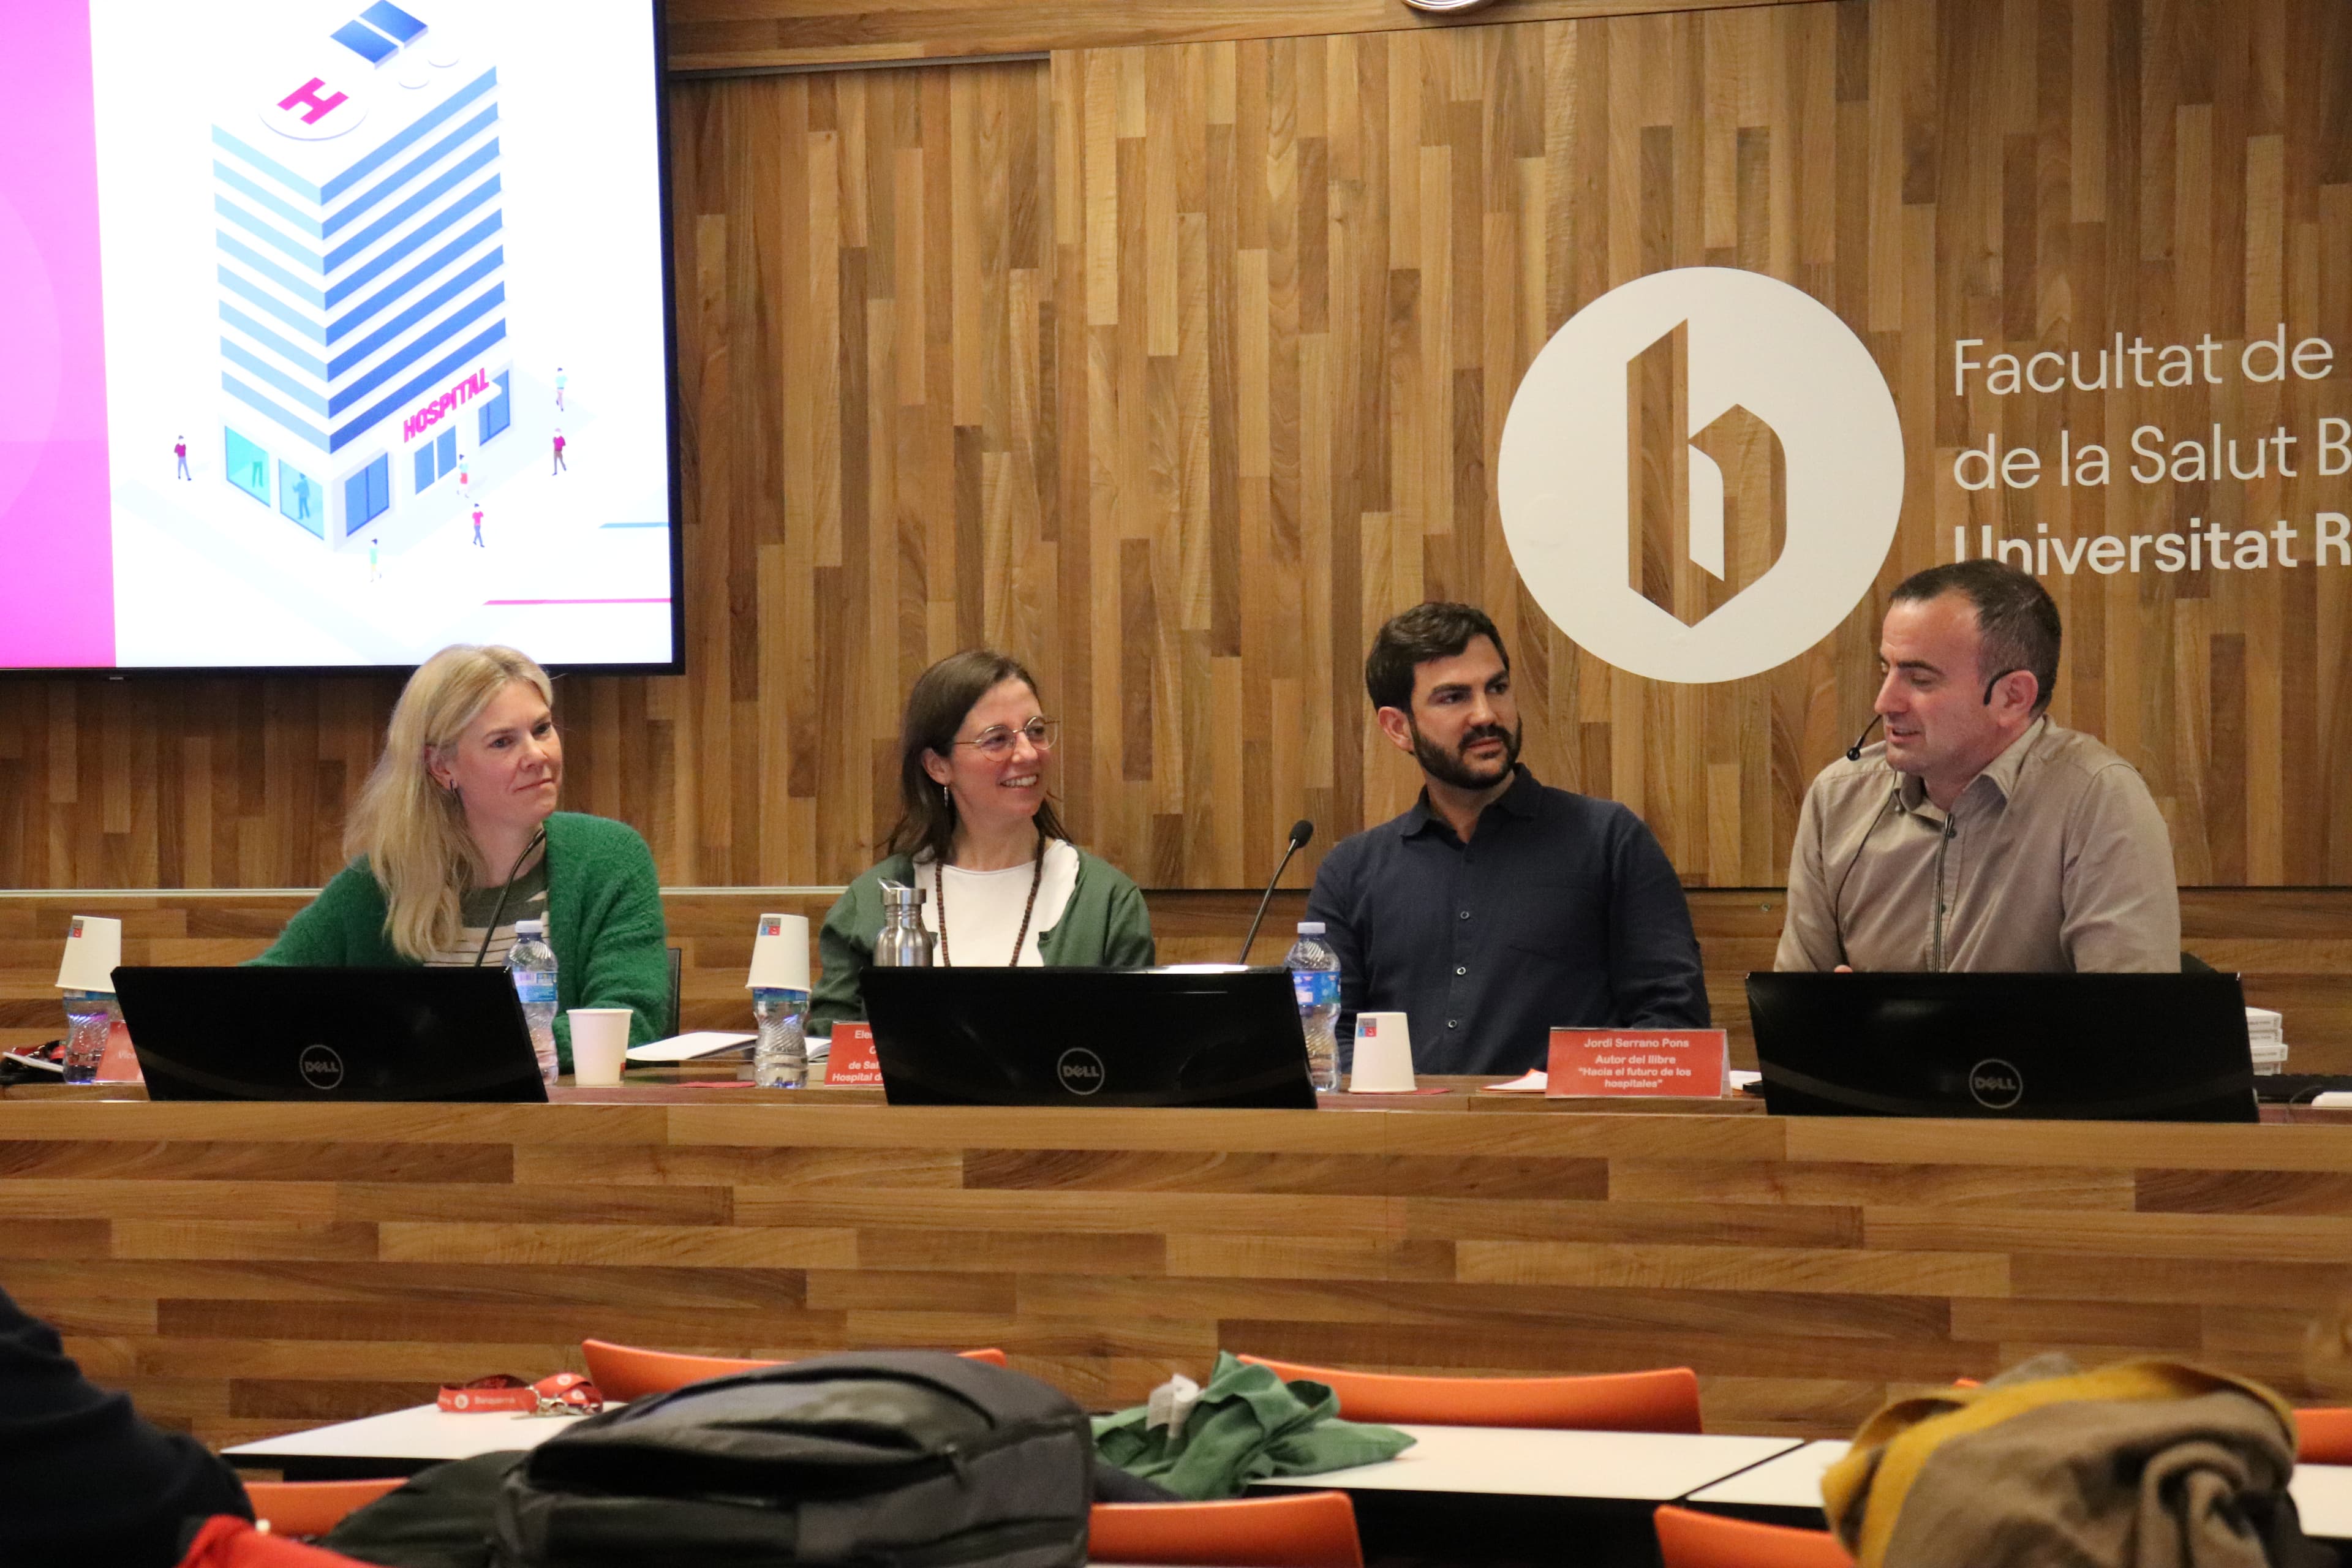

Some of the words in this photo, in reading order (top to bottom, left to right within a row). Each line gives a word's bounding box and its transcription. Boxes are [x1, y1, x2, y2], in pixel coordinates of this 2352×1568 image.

[1955, 331, 2223, 396] Facultat
[2240, 323, 2334, 383] de
[404, 368, 489, 443] HOSPITAL
[1954, 432, 2041, 491] de
[2061, 429, 2111, 487] la
[2130, 423, 2298, 484] Salut
[1954, 518, 2298, 575] Universitat
[1583, 1038, 1613, 1049] Jordi
[1615, 1038, 1660, 1049] Serrano
[1662, 1038, 1690, 1049] Pons
[848, 1060, 862, 1070] de
[1594, 1055, 1627, 1065] Autor
[1628, 1055, 1645, 1065] del
[1648, 1055, 1676, 1065] llibre
[304, 1061, 339, 1073] DELL
[1063, 1065, 1100, 1078] DELL
[1615, 1067, 1624, 1077] el
[1626, 1067, 1658, 1077] futuro
[1660, 1067, 1674, 1077] de
[1676, 1067, 1692, 1077] los
[832, 1072, 873, 1084] Hospital
[1974, 1077, 2017, 1090] DELL
